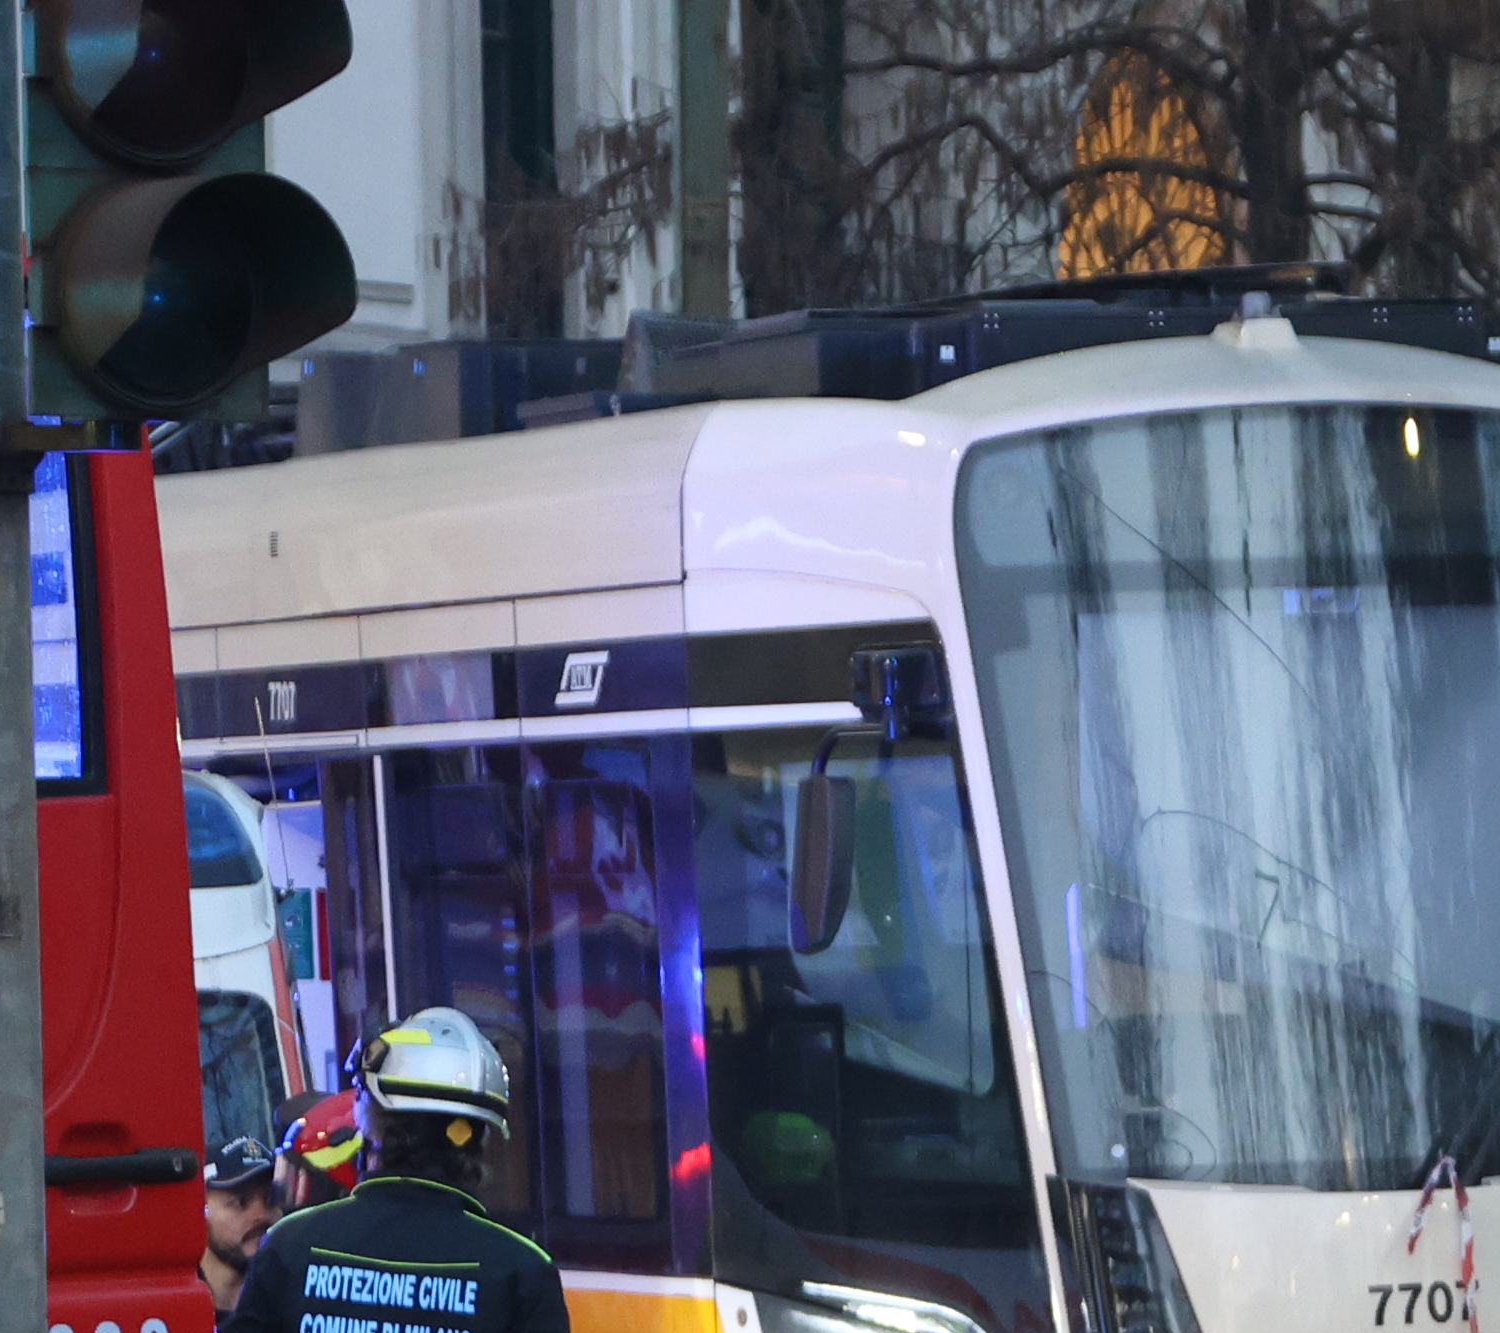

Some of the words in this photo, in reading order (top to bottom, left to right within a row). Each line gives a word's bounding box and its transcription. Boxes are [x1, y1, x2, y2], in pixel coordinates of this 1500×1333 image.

[267, 680, 297, 721] 7707
[304, 1264, 417, 1307] PROTEZIONE
[418, 1276, 478, 1315] CIVILE
[1367, 1280, 1480, 1327] 7707
